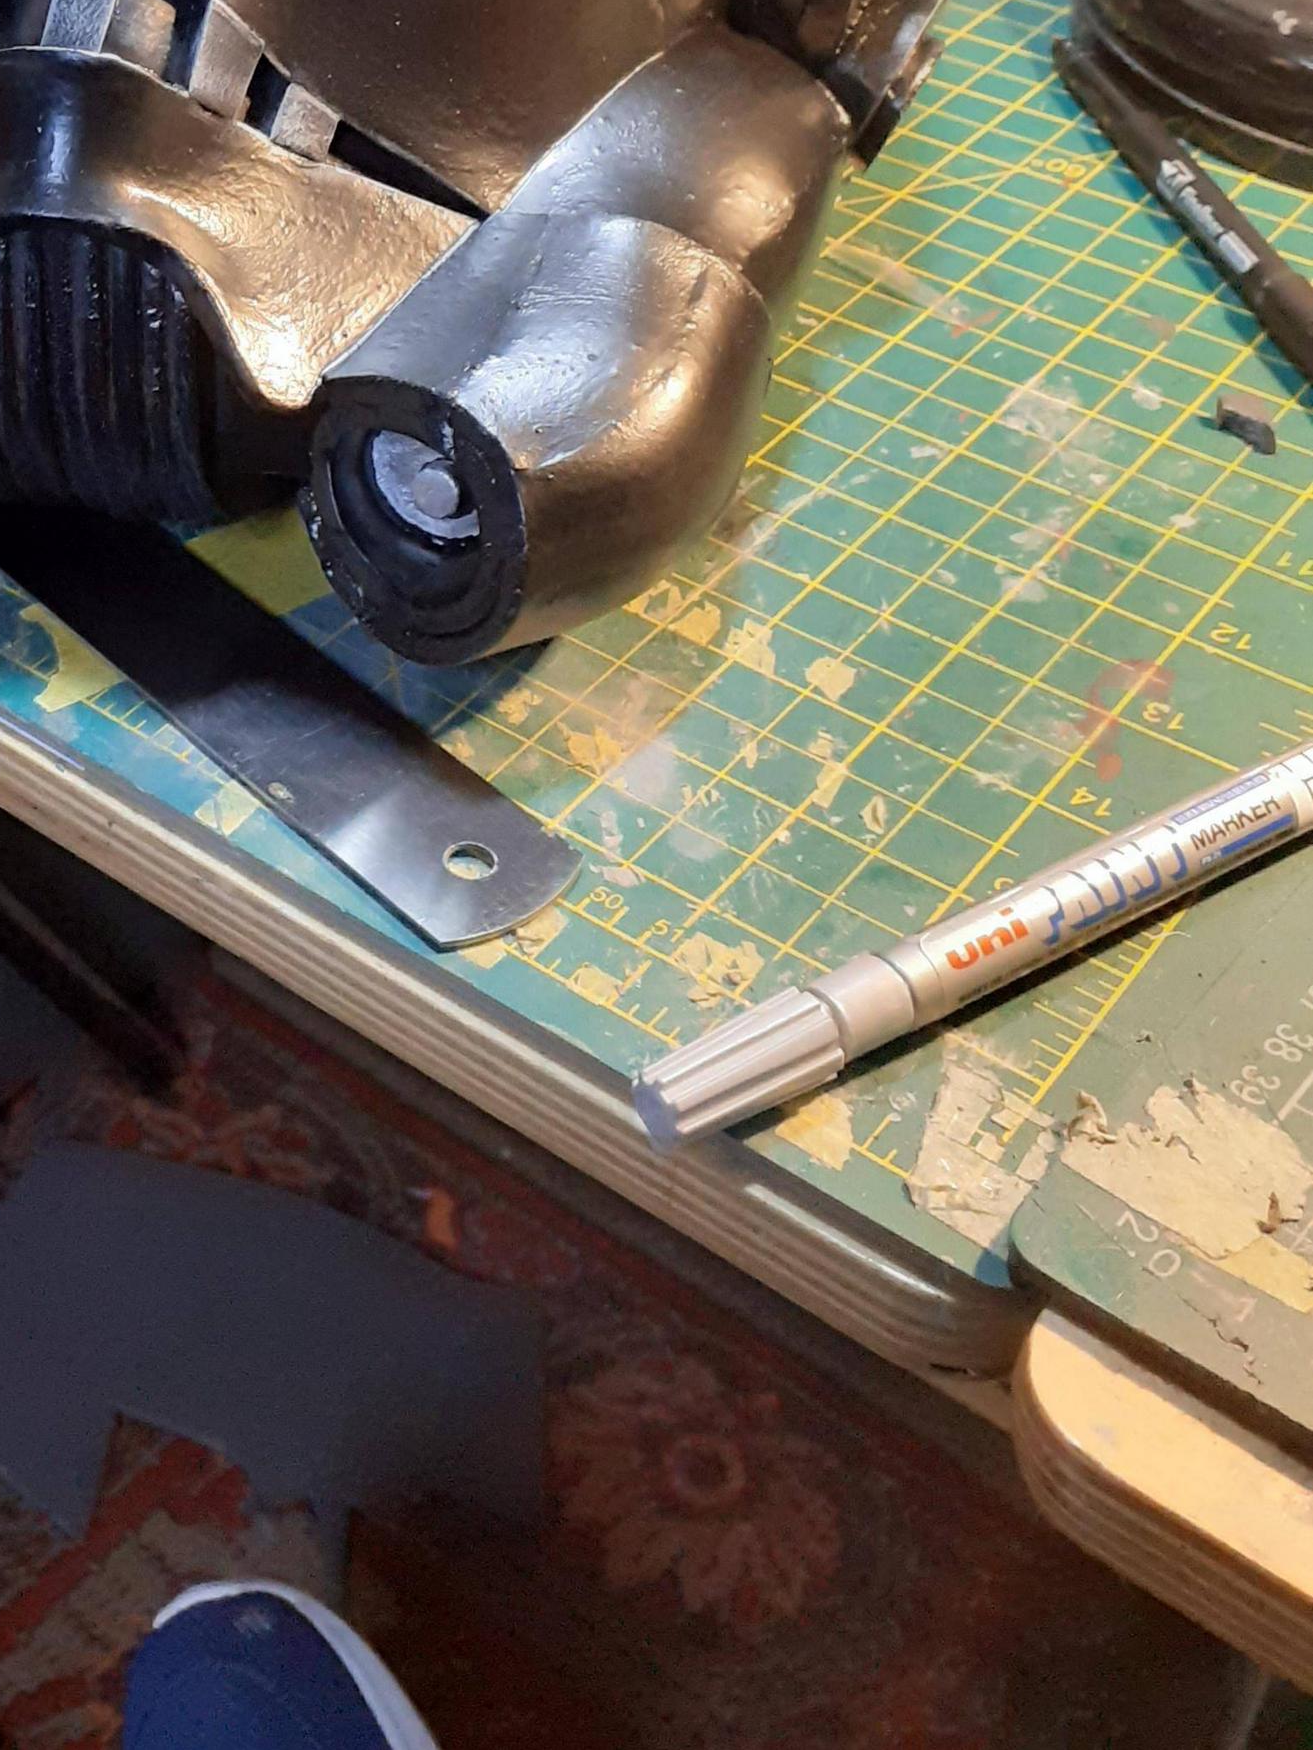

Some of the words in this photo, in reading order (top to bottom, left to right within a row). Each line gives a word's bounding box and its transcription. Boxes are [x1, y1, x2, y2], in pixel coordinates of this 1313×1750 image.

[1208, 622, 1253, 650] 12
[1141, 701, 1185, 731] 13
[1069, 787, 1113, 817] 14
[588, 885, 625, 911] 50
[650, 920, 686, 944] 51
[945, 905, 1031, 971] uni
